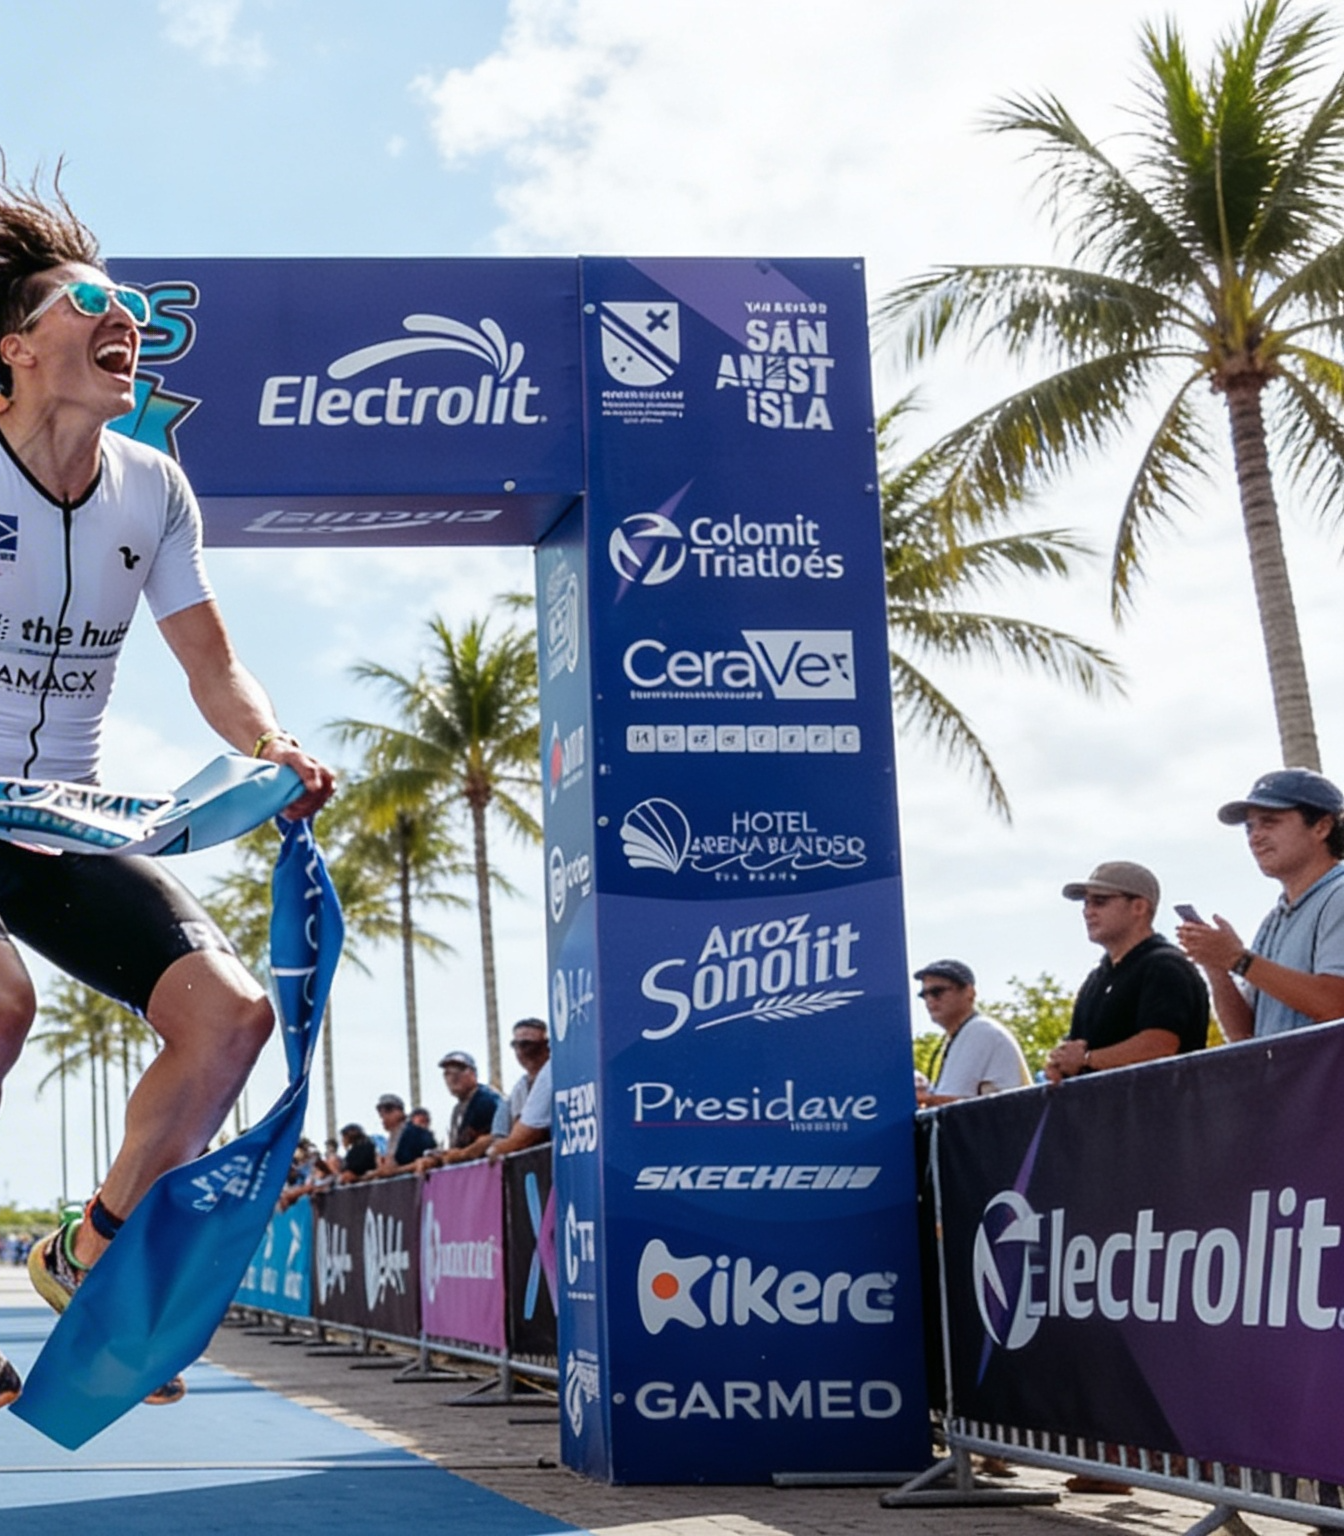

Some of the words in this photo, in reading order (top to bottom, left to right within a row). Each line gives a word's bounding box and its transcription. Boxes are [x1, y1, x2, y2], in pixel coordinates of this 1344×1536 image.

[690, 514, 820, 546] Colomit
[22, 616, 74, 646] the
[732, 811, 818, 834] HOTEL
[699, 914, 810, 964] Arroz
[641, 923, 860, 1040] Sonolit
[634, 1380, 903, 1419] GARMEO
